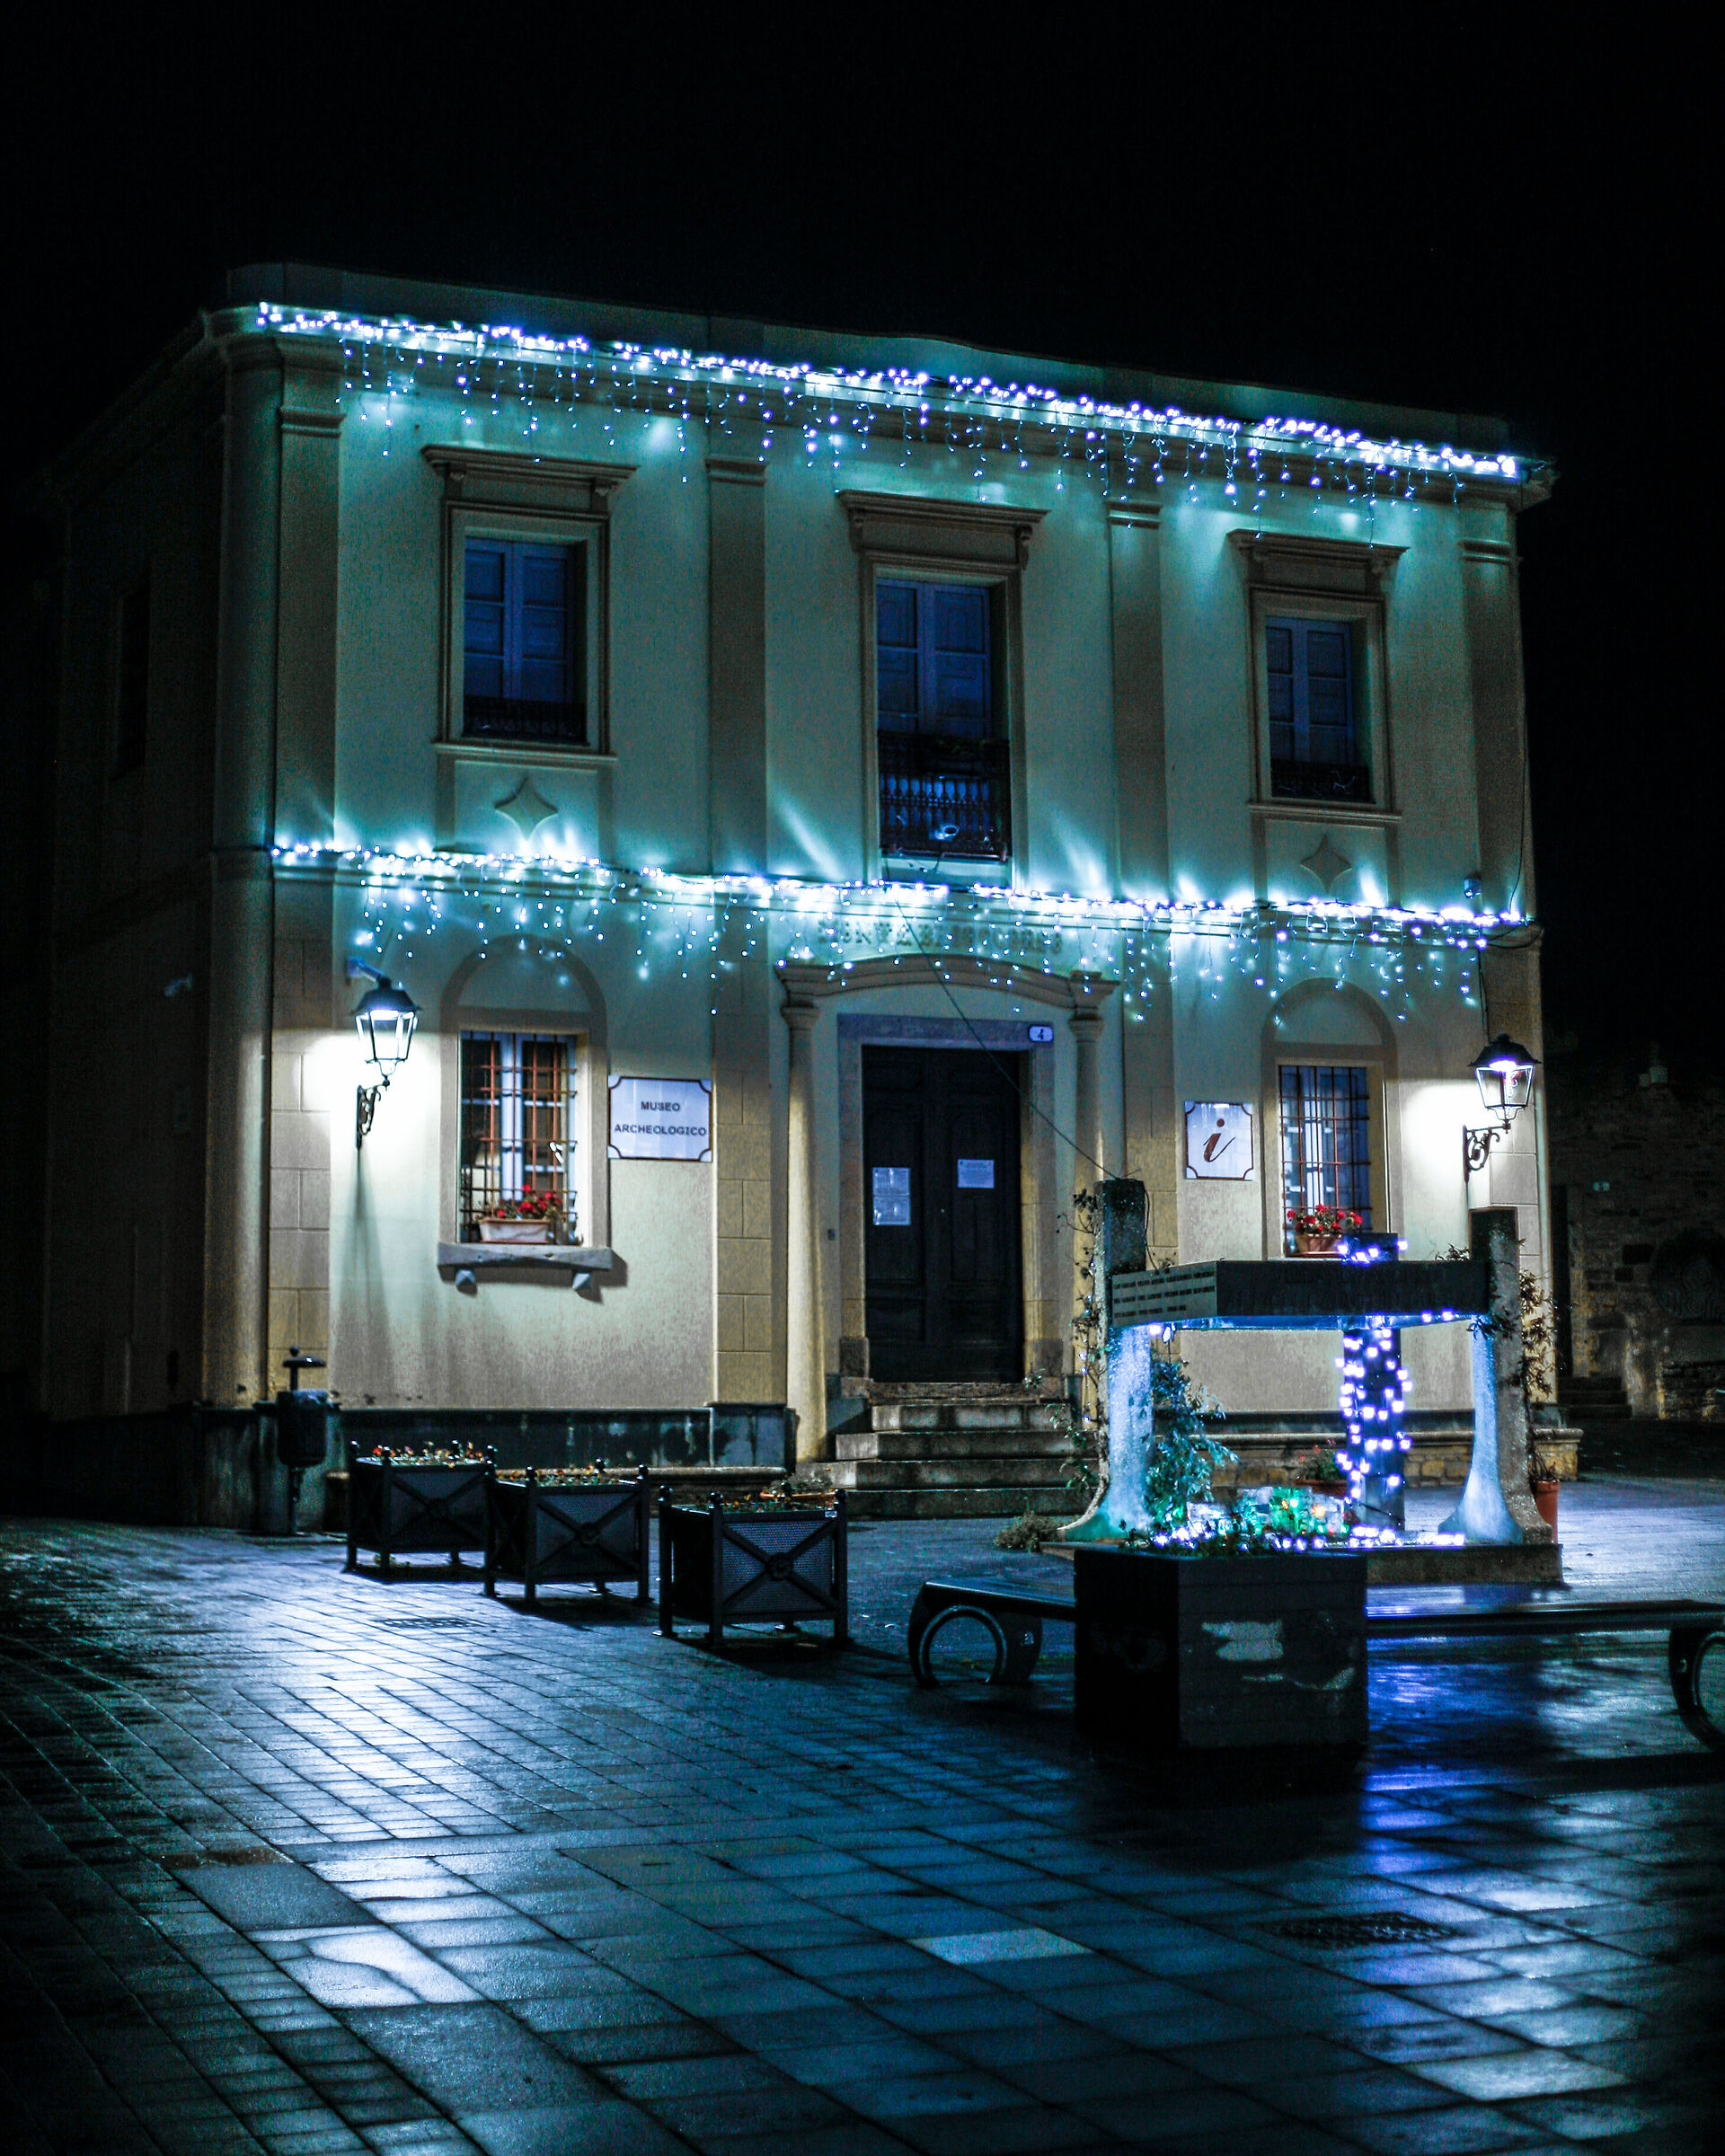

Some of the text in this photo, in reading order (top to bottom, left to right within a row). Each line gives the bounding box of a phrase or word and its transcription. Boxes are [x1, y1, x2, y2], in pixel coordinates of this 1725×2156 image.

[641, 1101, 680, 1111] MUSEO
[614, 1124, 706, 1135] ARCHEOLOGICO
[1202, 1118, 1236, 1163] i
